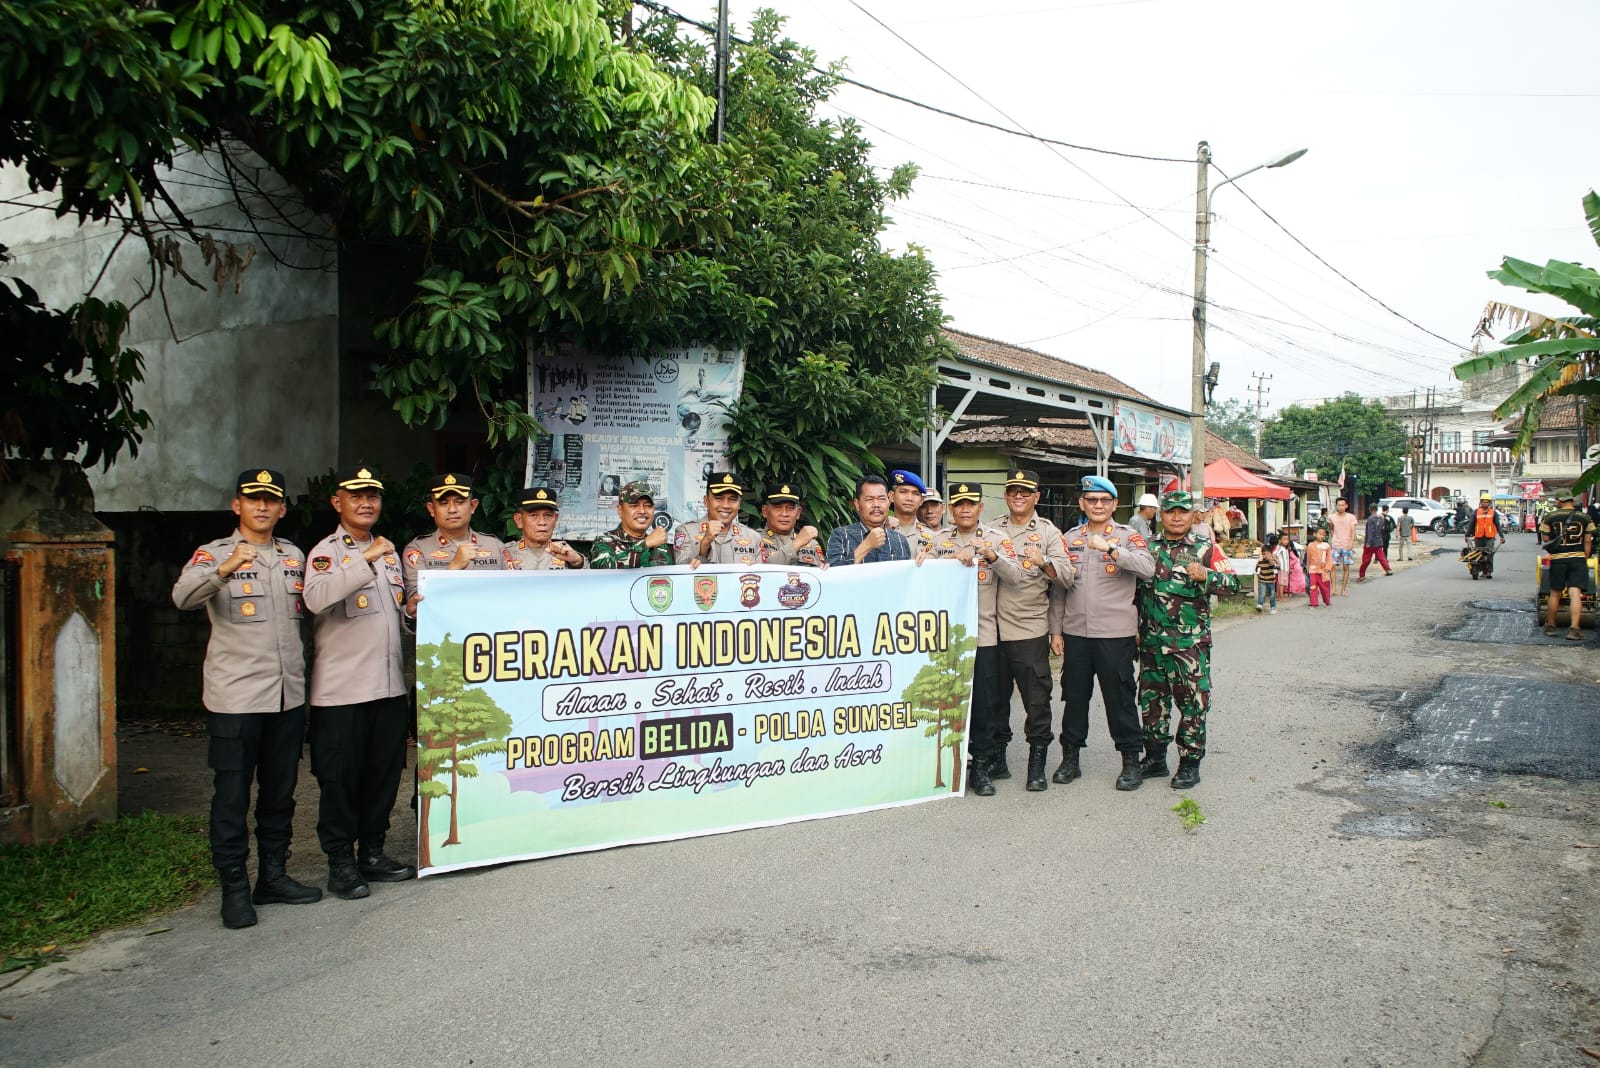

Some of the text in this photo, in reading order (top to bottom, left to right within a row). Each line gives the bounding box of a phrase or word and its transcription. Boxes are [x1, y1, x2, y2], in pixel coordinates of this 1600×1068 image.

[614, 379, 655, 387] melahirkan
[463, 610, 948, 683] GERAKAN INDONESIA ASRI
[556, 686, 627, 716] Aman
[652, 677, 724, 706] Sehat
[745, 669, 805, 699] Resik
[825, 663, 883, 692] Indah
[506, 727, 635, 769] PROGRAM
[643, 719, 729, 755] BELIDA
[754, 709, 826, 744] POLDA
[834, 702, 918, 734] SUMSEL
[561, 743, 884, 801] Bersih Lingkungan dan Asri
